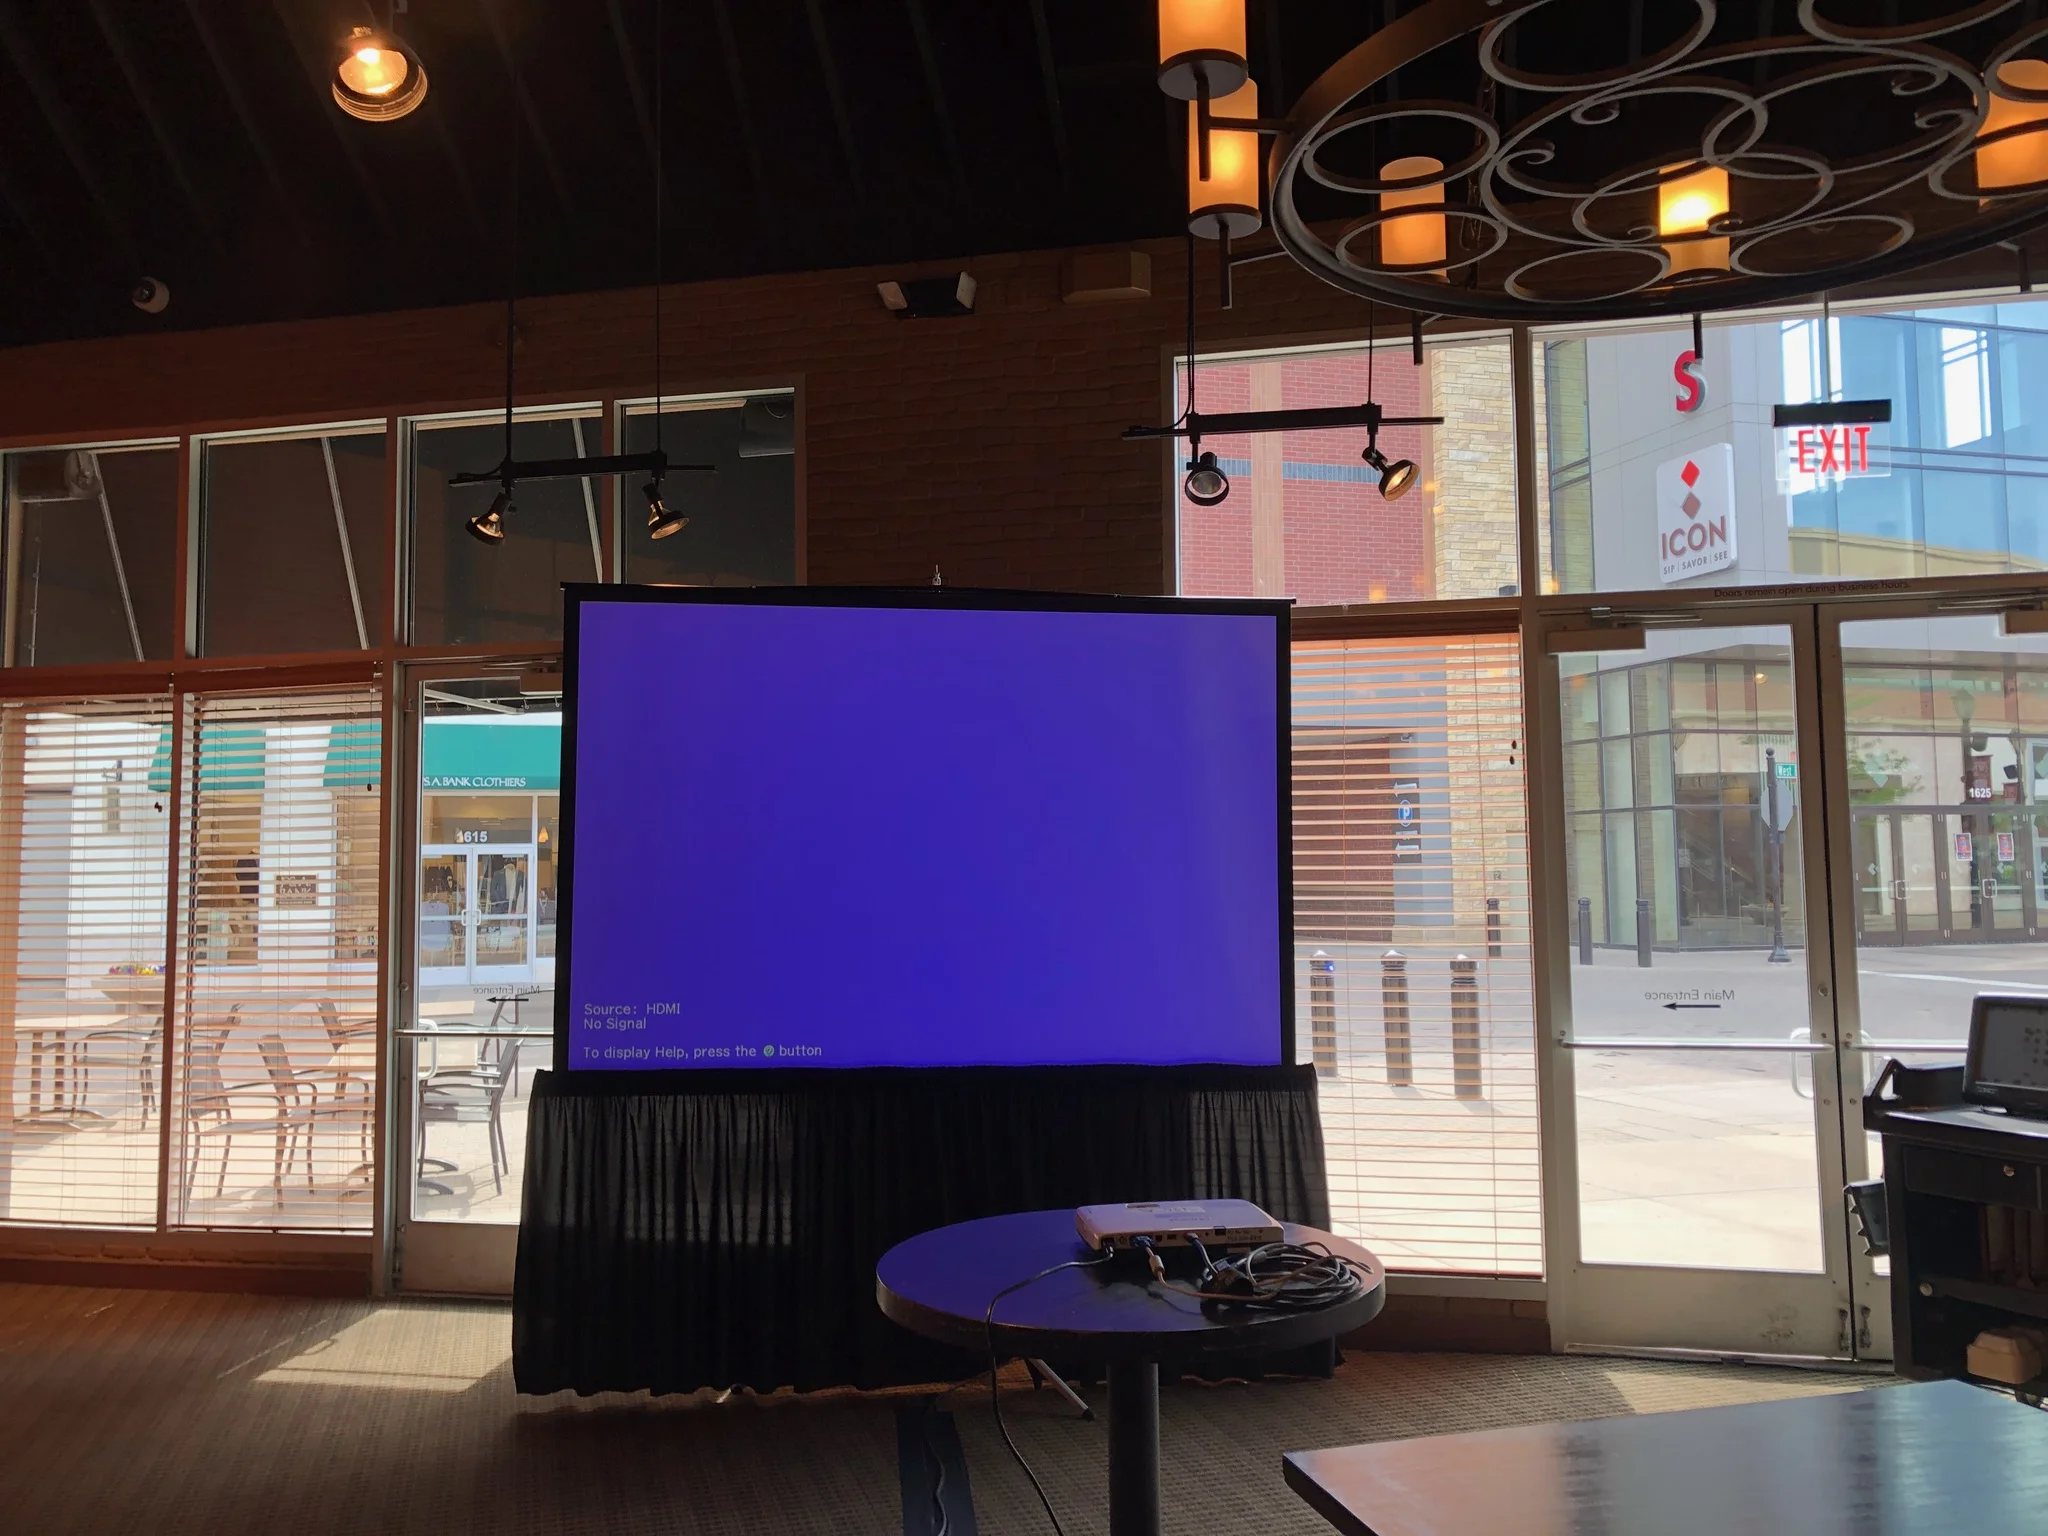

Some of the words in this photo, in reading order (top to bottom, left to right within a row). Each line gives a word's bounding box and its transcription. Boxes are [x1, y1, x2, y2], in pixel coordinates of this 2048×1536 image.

[1798, 426, 1872, 474] EXIT
[1661, 515, 1726, 561] ICON
[1663, 565, 1675, 575] SIP
[1682, 556, 1708, 570] SAVOR
[1713, 550, 1728, 561] SEE
[1714, 588, 1743, 598] Doors
[1744, 588, 1776, 597] remain
[1778, 586, 1803, 597] open
[1805, 583, 1836, 594] during
[1838, 580, 1879, 592] business
[1881, 579, 1912, 589] hours.
[1778, 764, 1792, 777] West
[442, 776, 472, 787] BANK
[472, 776, 527, 788] CLOTHIERS
[1969, 787, 1992, 799] 1625
[456, 830, 488, 843] 1615
[584, 1003, 637, 1016] Source:
[646, 1003, 681, 1015] HDMI
[583, 1018, 602, 1030] No
[606, 1017, 647, 1031] Signal
[583, 1047, 600, 1059] To
[604, 1046, 651, 1061] display
[655, 1046, 689, 1060] Help,
[693, 1047, 731, 1060] press
[735, 1045, 757, 1057] the
[779, 1045, 822, 1057] button
